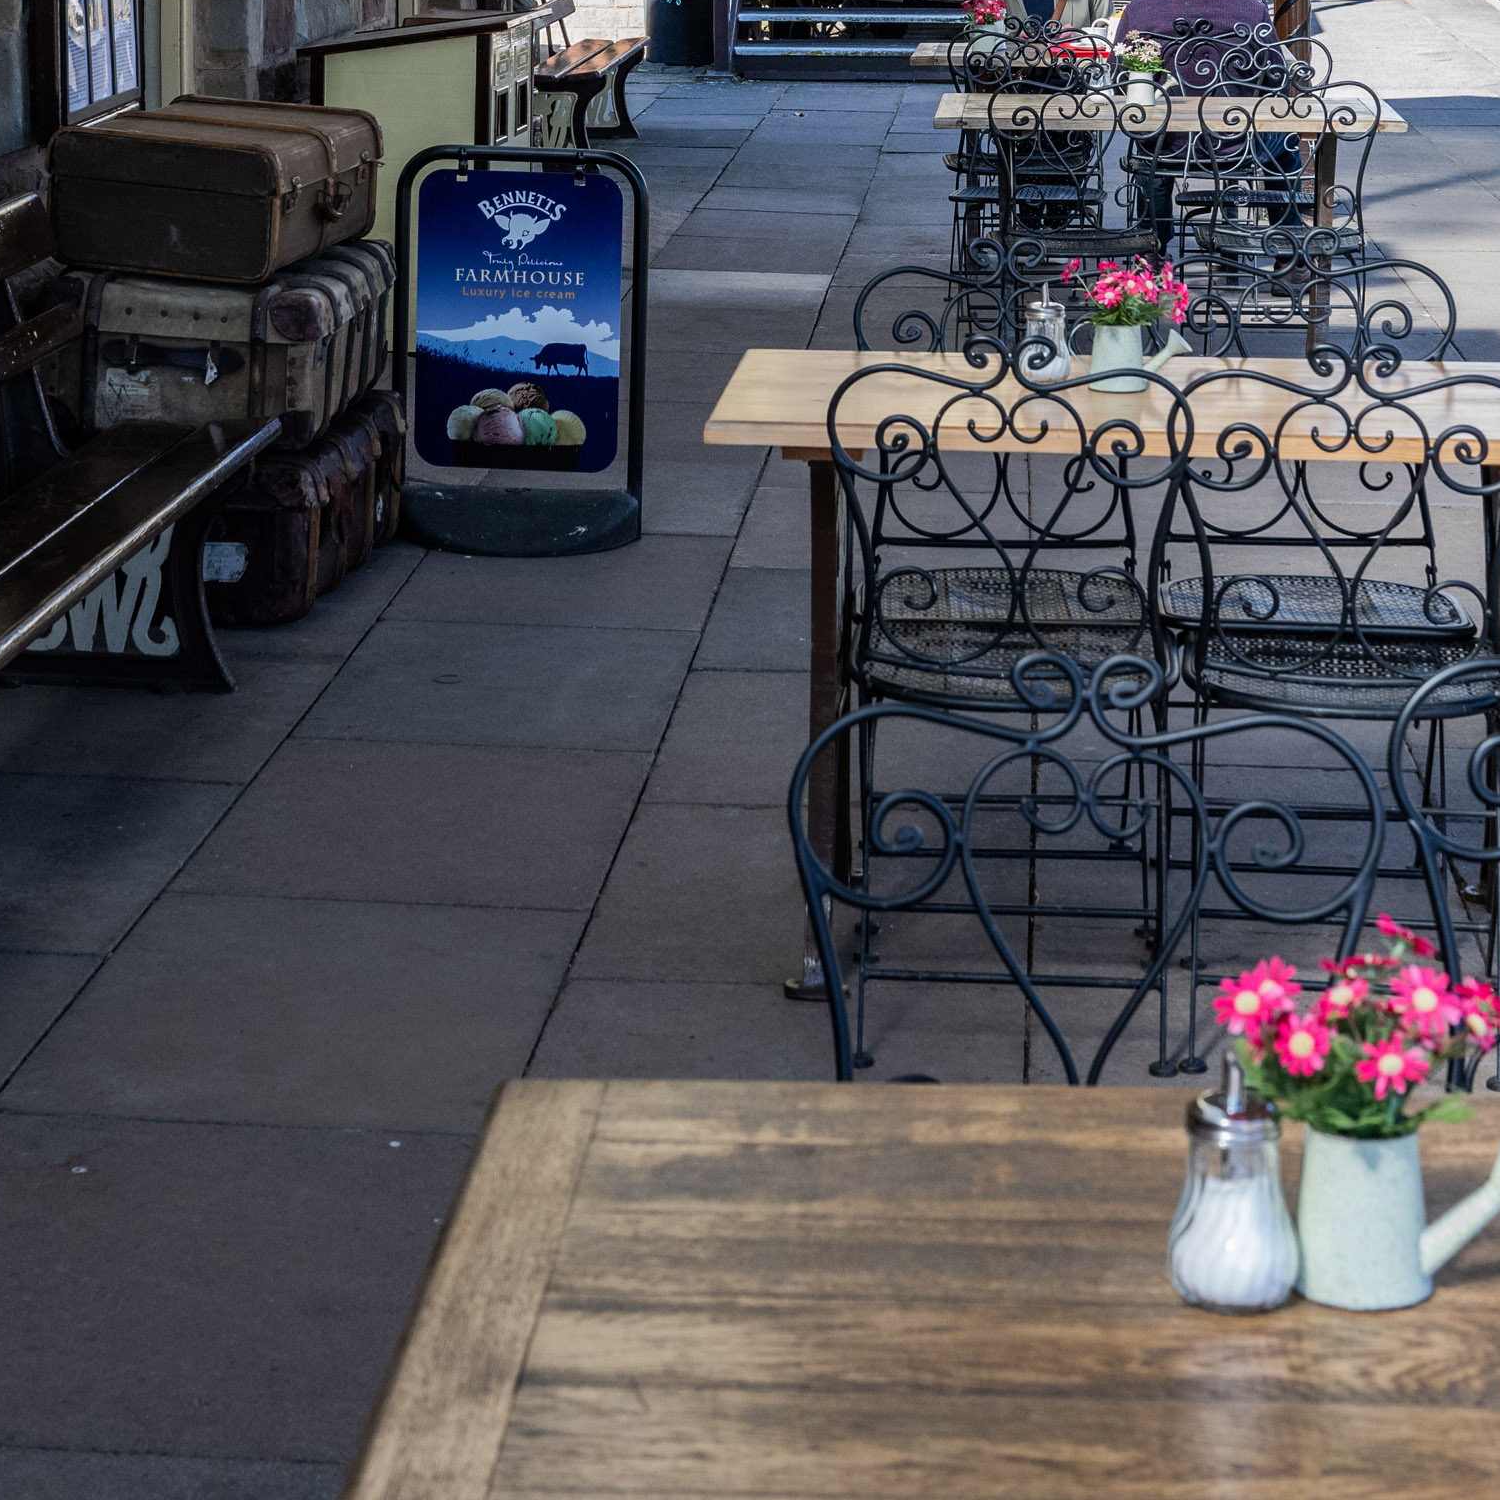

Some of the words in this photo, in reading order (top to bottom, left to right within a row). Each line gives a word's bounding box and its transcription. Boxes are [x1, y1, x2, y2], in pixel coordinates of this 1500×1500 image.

[477, 190, 567, 221] BENNETTS
[483, 251, 514, 272] Truly
[518, 252, 563, 266] Delicious
[455, 268, 585, 286] FARMHOUSE
[462, 286, 506, 299] Luxury
[536, 289, 576, 300] cream
